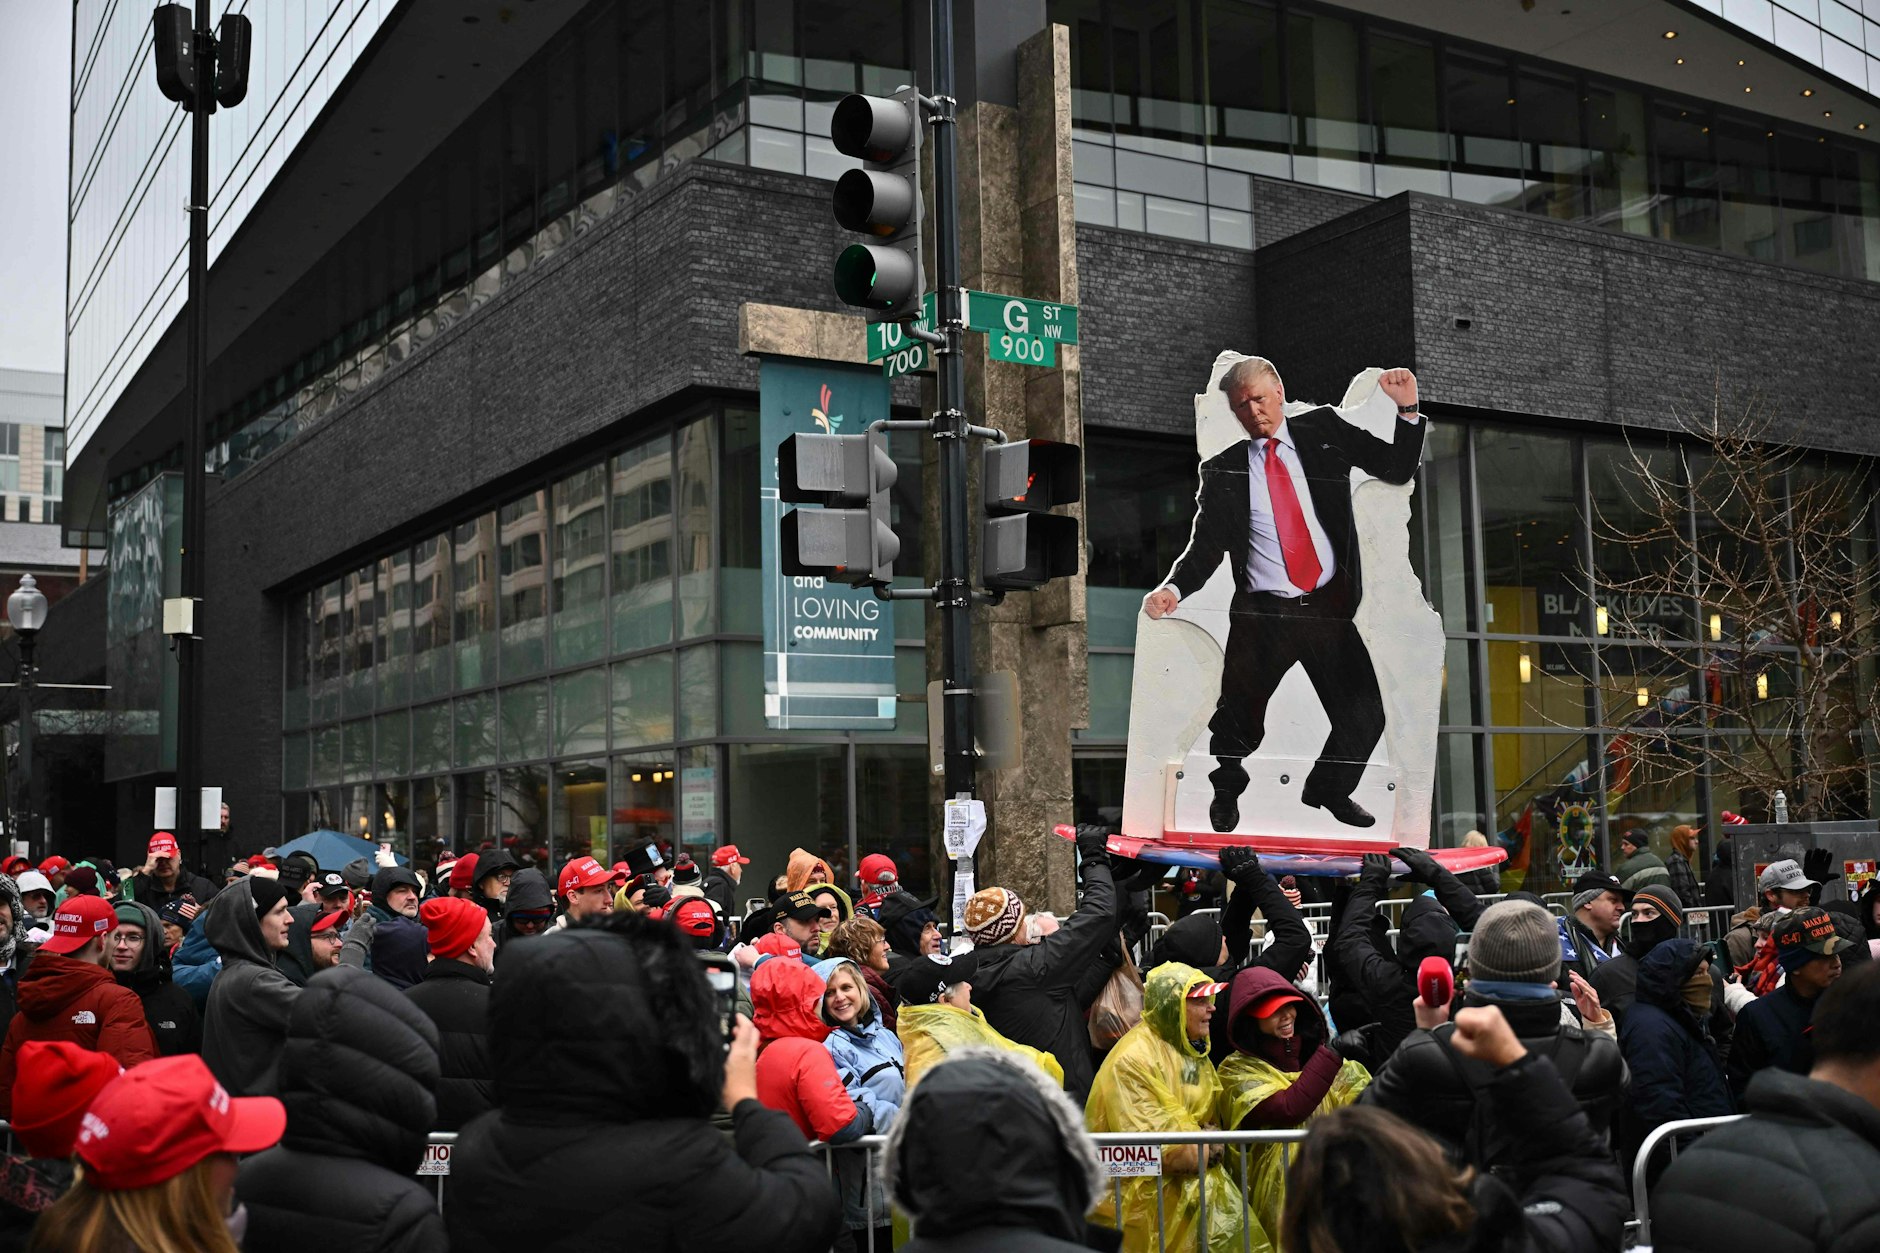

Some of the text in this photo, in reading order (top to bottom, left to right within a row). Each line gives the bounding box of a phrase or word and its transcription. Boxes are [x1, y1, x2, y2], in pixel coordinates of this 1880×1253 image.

[1003, 300, 1061, 334] G ST
[1044, 324, 1062, 339] NW
[1000, 335, 1044, 362] 900
[886, 345, 923, 378] 700
[793, 576, 824, 588] and
[794, 597, 880, 620] LOVING
[793, 625, 879, 641] COMMUNITY
[1803, 917, 1823, 930] MAKE
[1098, 1146, 1158, 1162] TIONAL
